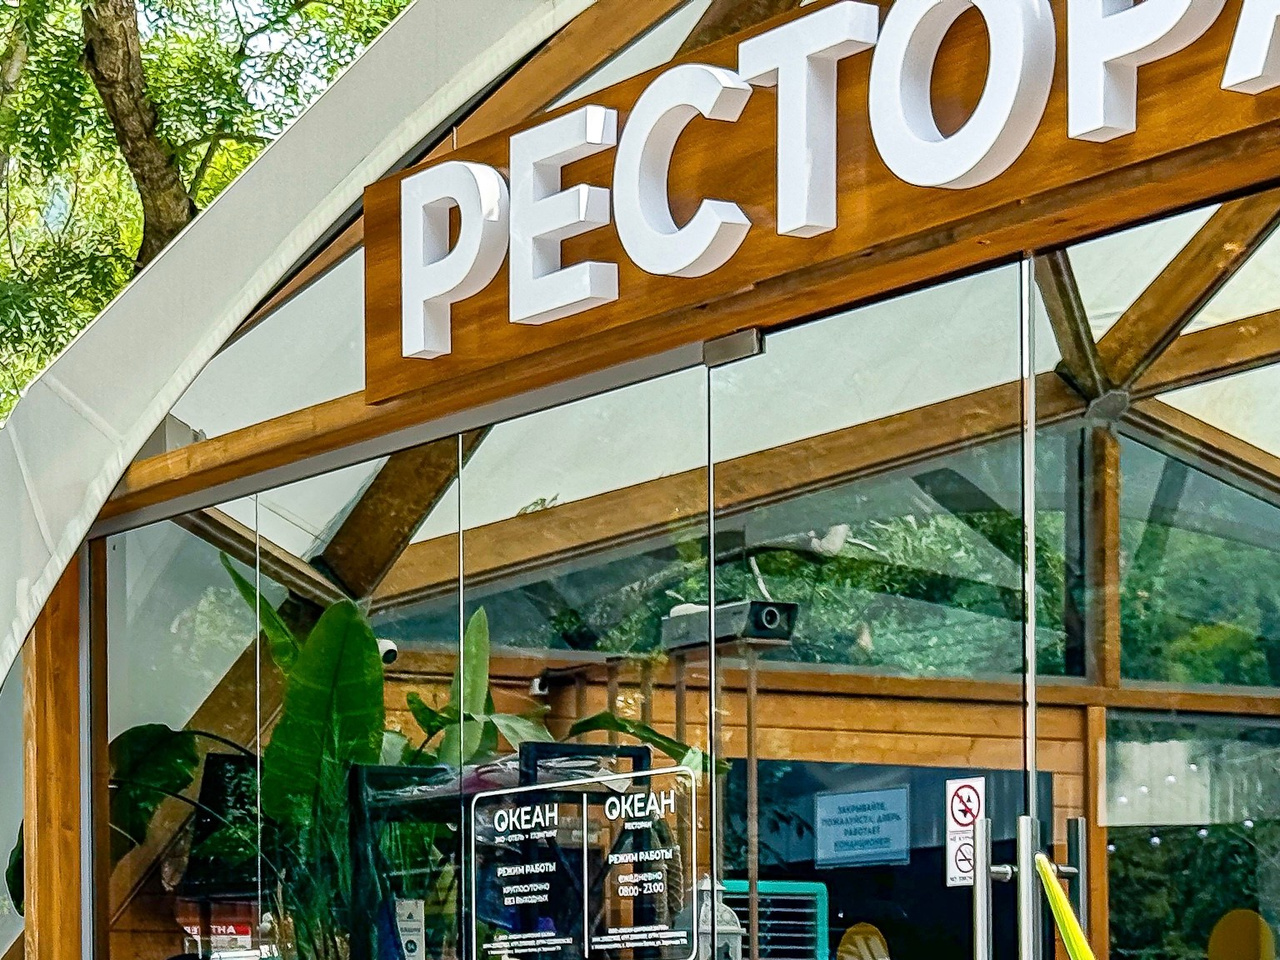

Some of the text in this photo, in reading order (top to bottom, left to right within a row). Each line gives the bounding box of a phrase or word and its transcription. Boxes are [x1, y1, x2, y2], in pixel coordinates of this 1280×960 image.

[605, 789, 675, 820] ОКЕАН
[494, 803, 558, 832] ОКЕАН
[608, 849, 673, 864] РЕЖИМ РАБОТЫ
[497, 862, 556, 877] РЕЖИМ РАБОТЫ
